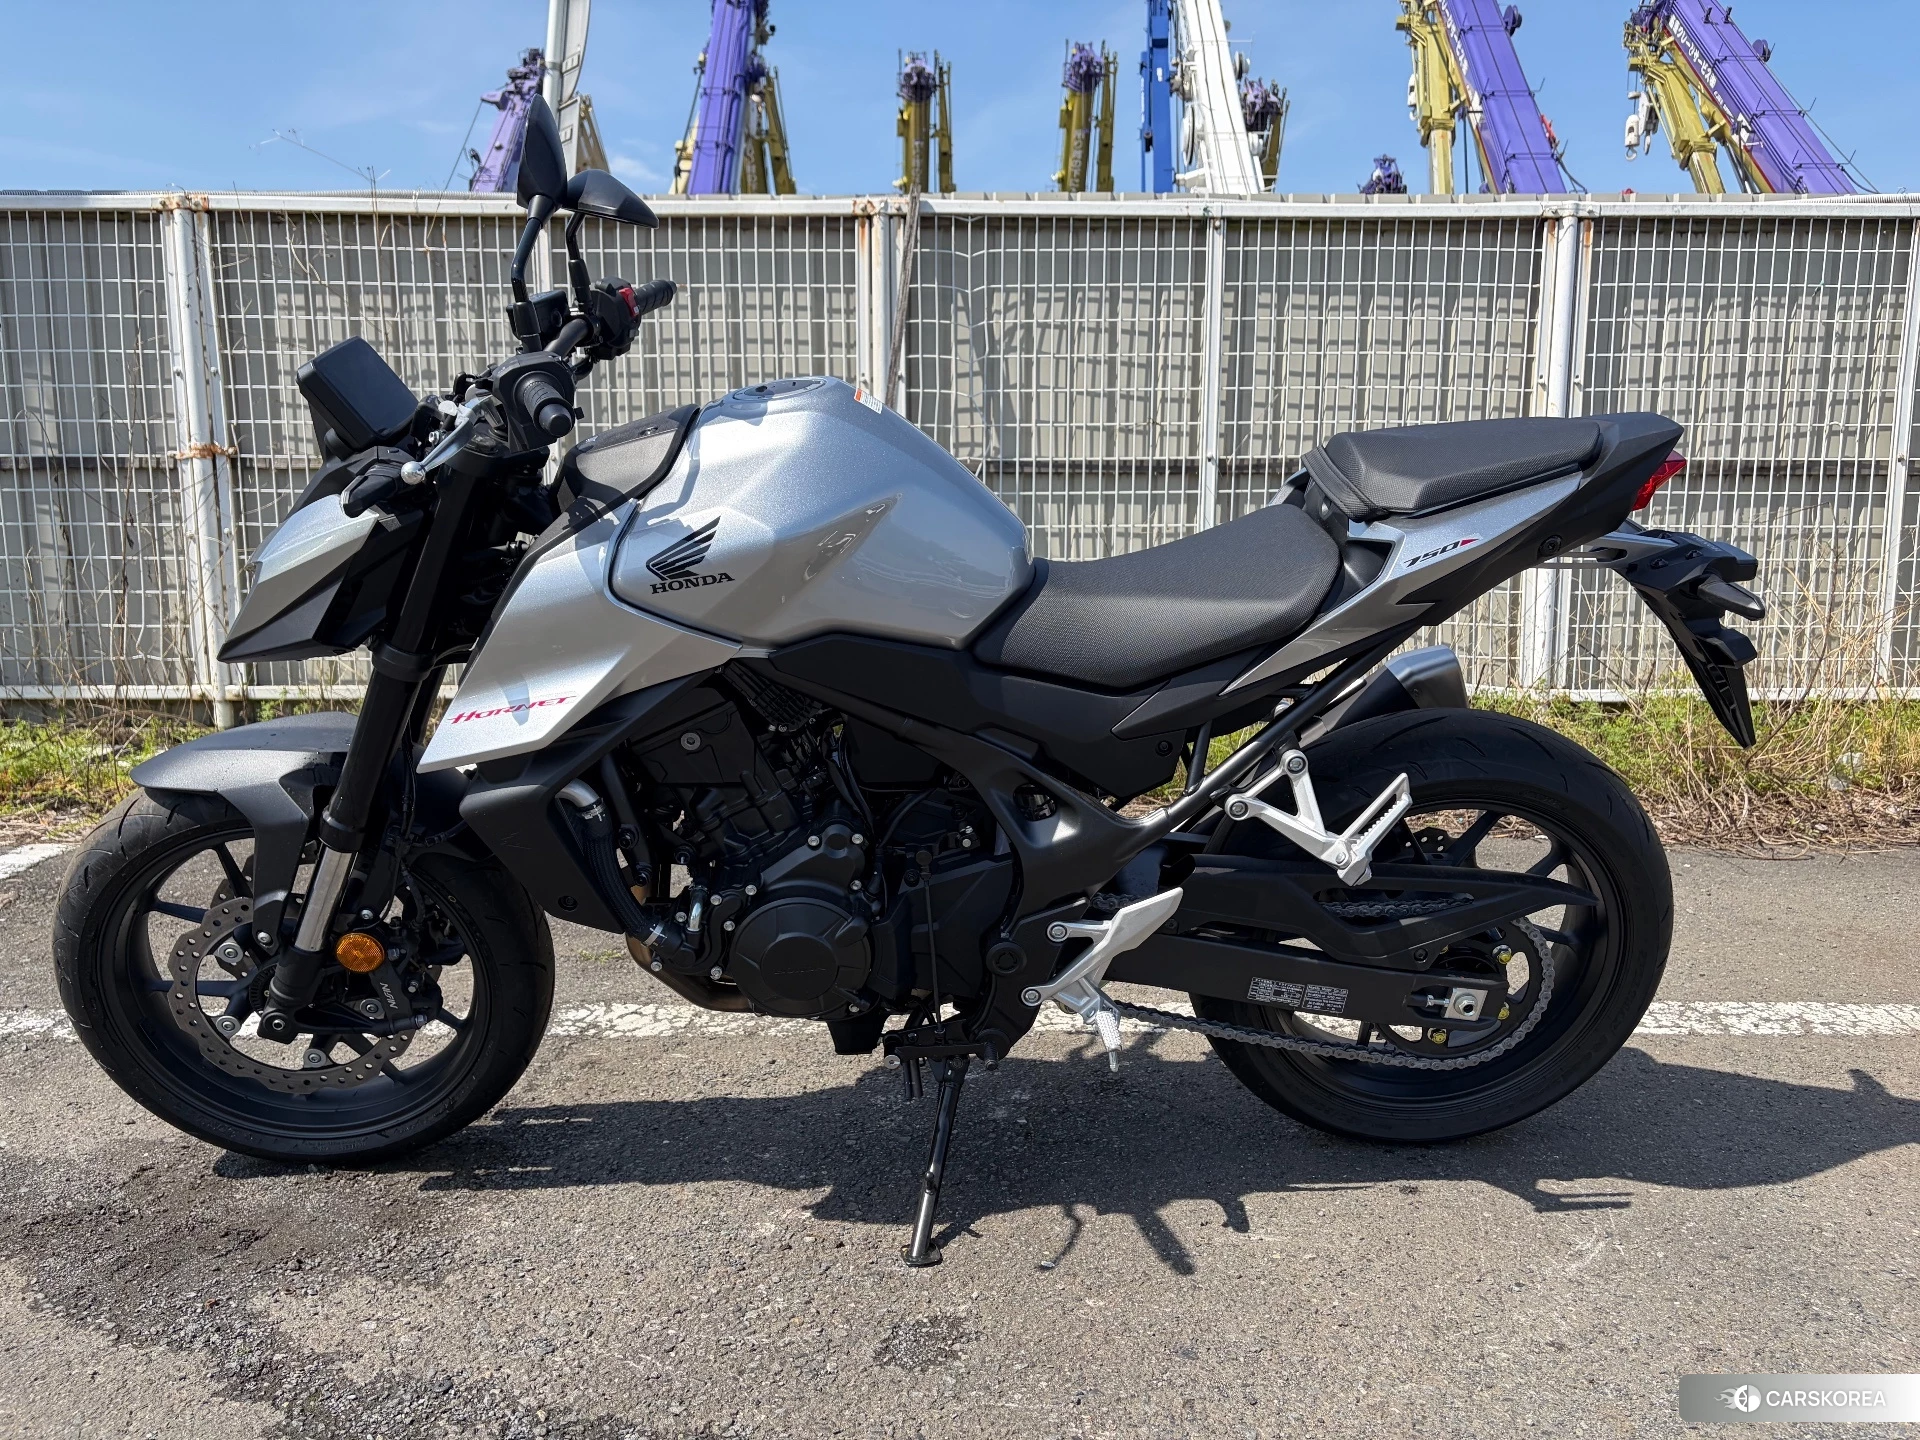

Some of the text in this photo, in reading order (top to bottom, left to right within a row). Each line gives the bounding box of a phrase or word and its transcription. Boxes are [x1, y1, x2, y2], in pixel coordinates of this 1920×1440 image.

[1403, 541, 1461, 568] 750
[650, 572, 735, 594] HONDA
[447, 696, 577, 724] HORNET
[380, 982, 398, 1009] NISSIN
